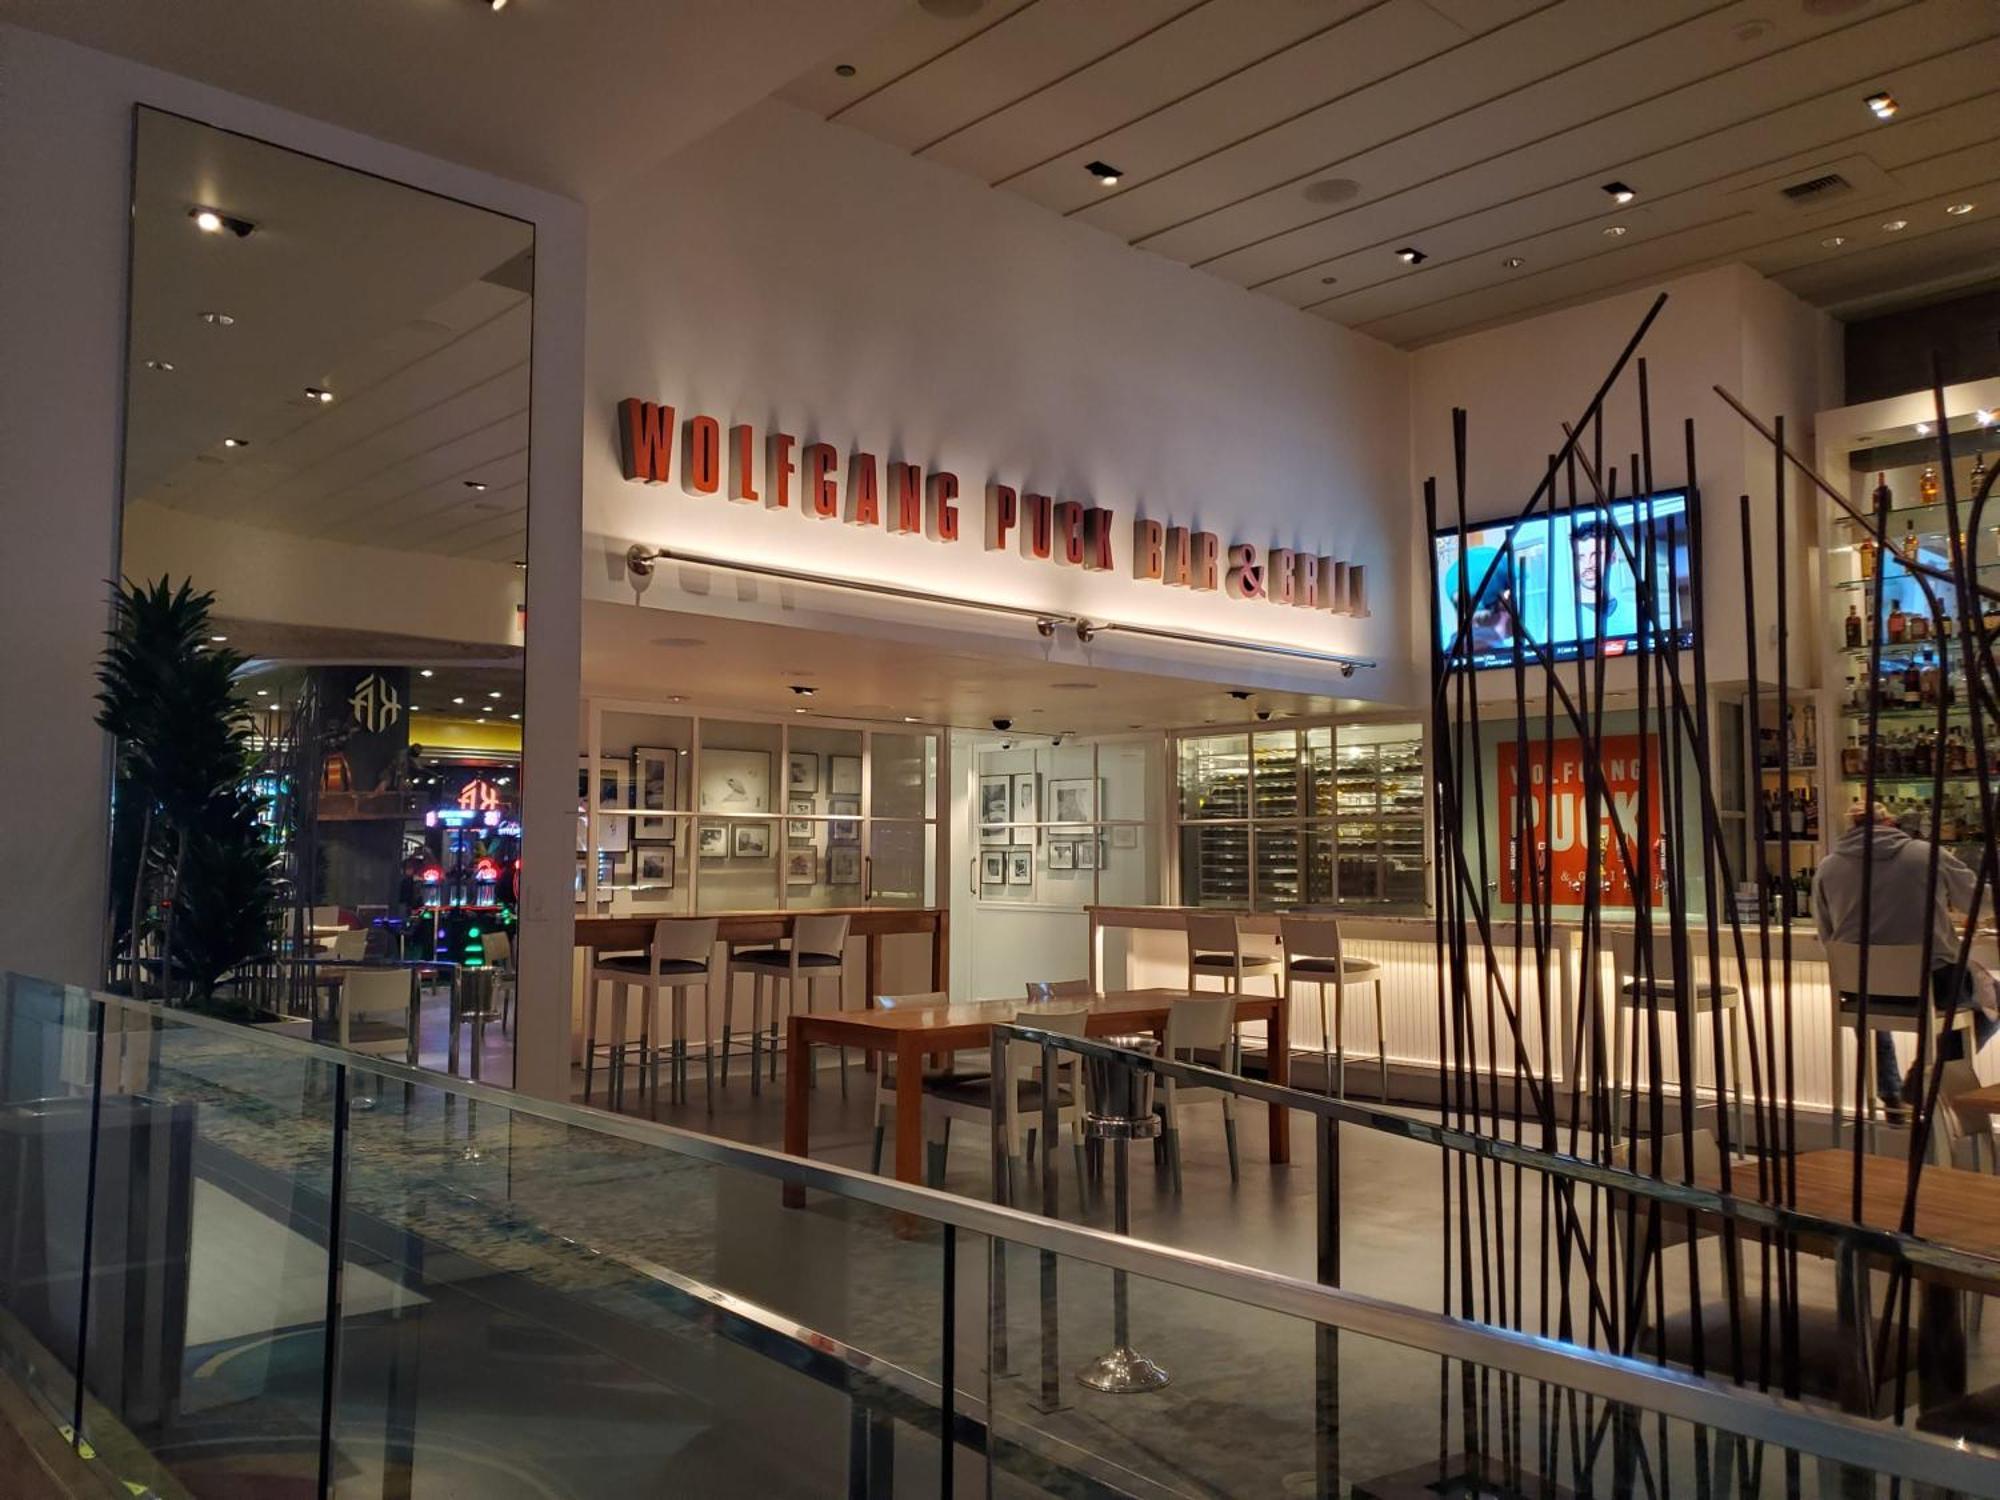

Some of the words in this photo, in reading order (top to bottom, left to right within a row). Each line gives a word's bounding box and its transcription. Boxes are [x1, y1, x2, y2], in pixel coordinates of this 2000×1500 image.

[618, 397, 960, 544] WOLFGANG
[985, 483, 1114, 572] PUCK
[1133, 518, 1218, 592] BAR
[1226, 543, 1266, 600] &
